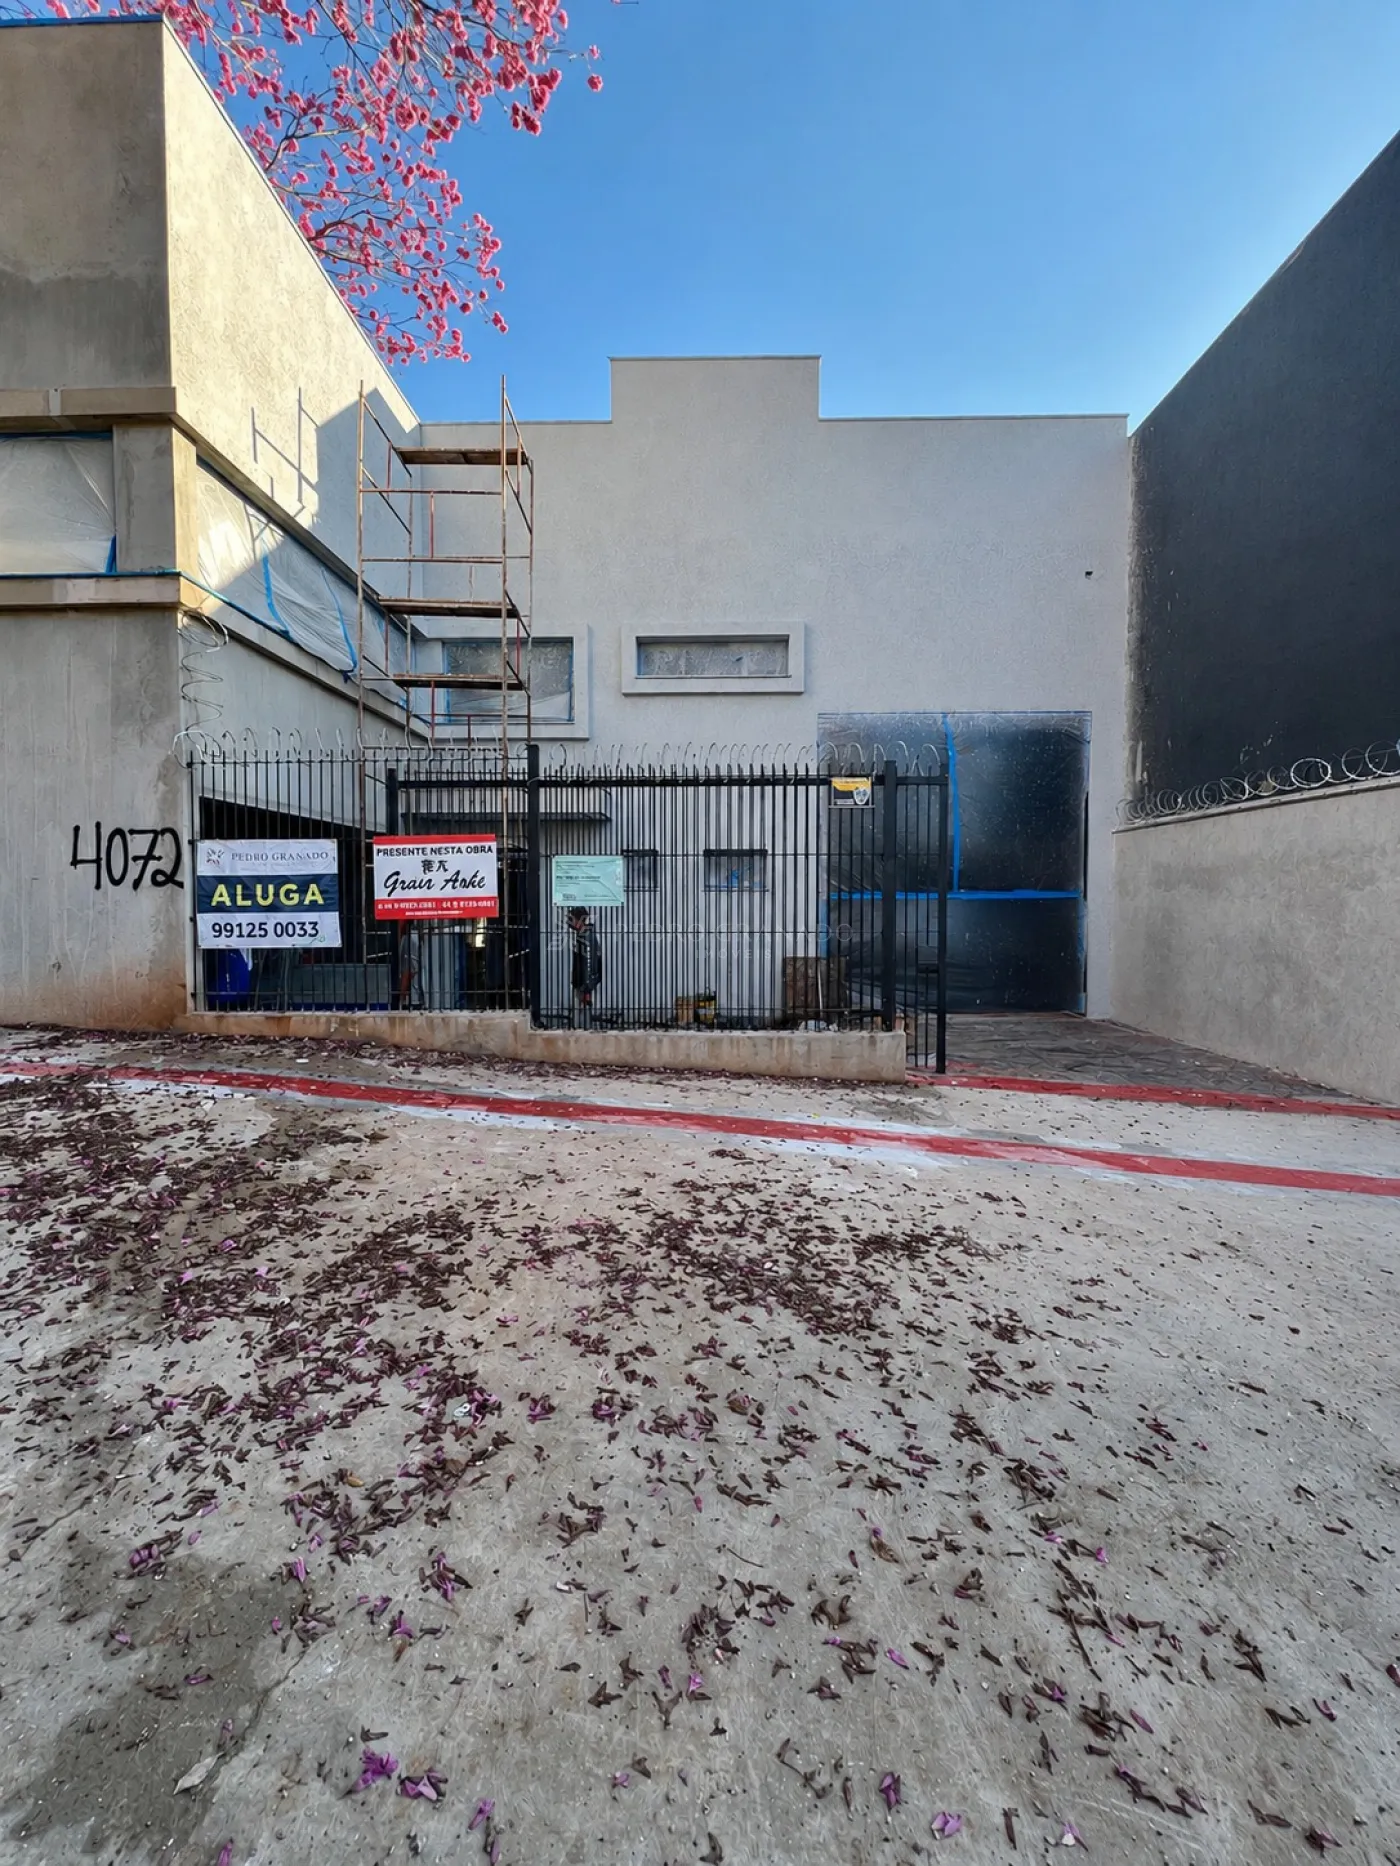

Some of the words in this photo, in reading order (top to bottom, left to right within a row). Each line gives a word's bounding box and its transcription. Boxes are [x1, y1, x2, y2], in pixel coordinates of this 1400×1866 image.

[70, 821, 184, 892] 4072
[231, 852, 269, 861] PEDRO
[271, 851, 329, 860] GRANADO
[376, 847, 428, 857] PRESENTE
[430, 846, 463, 855] NESTA
[465, 845, 493, 854] OBRA
[211, 883, 324, 907] ALUGA
[212, 922, 268, 938] 99125
[273, 921, 319, 938] 0033
